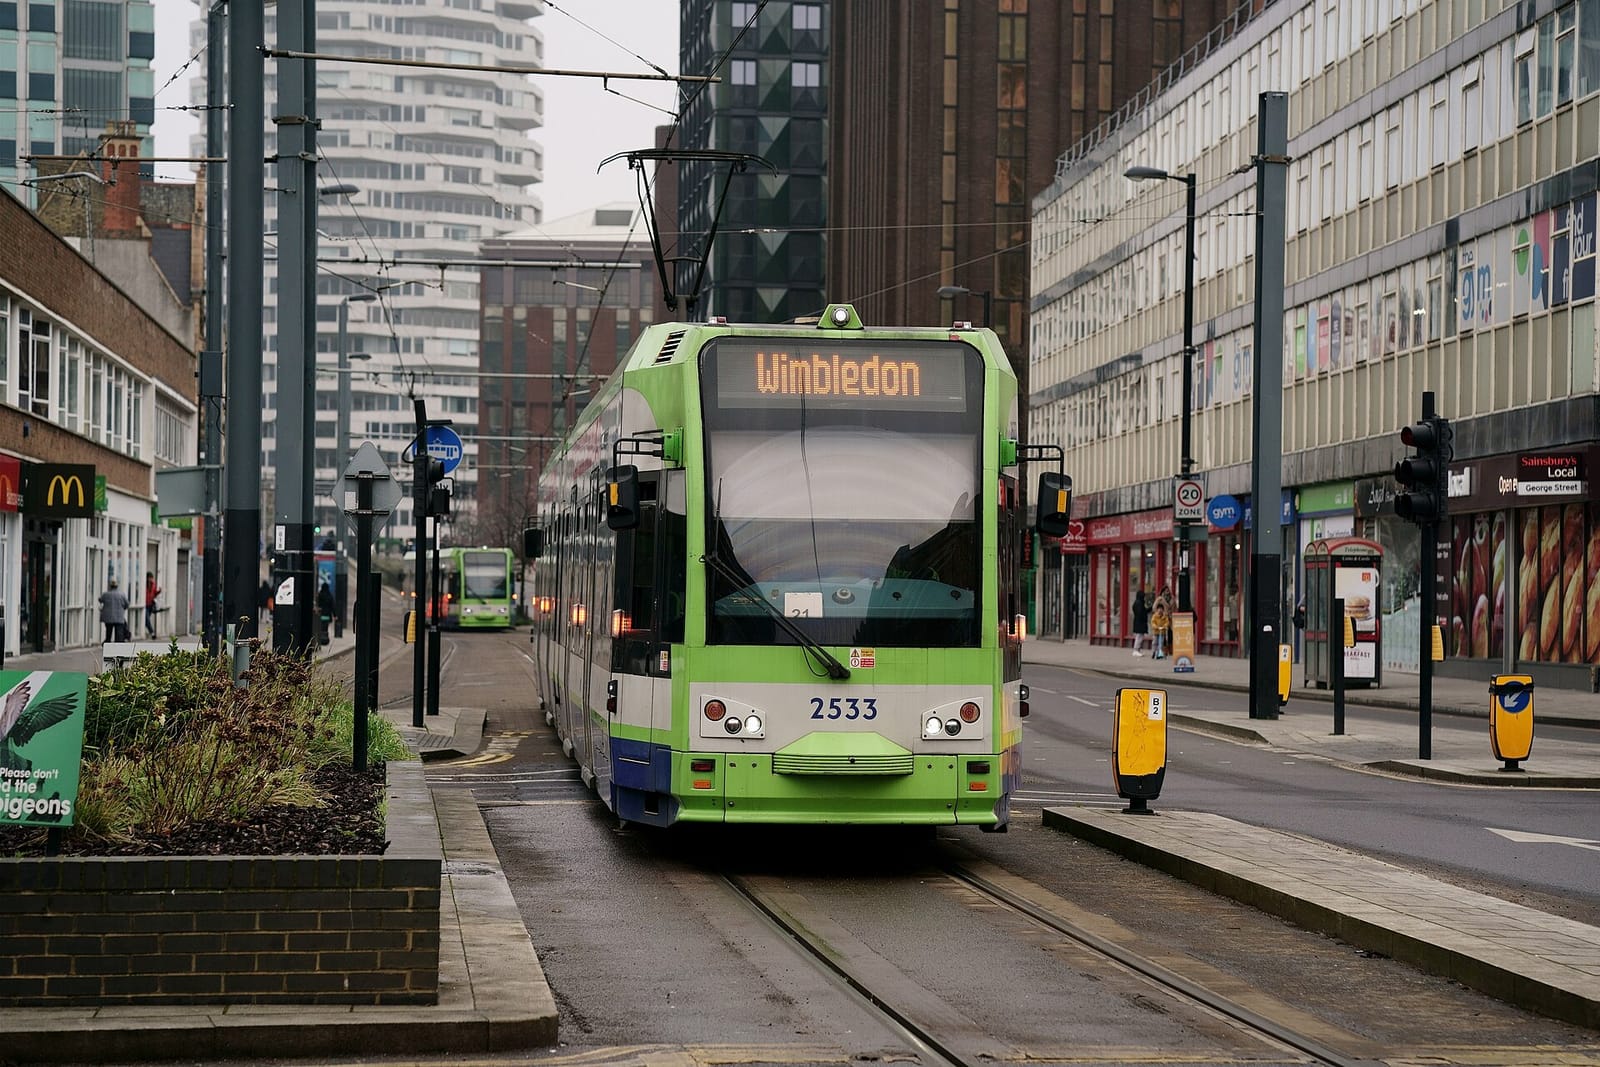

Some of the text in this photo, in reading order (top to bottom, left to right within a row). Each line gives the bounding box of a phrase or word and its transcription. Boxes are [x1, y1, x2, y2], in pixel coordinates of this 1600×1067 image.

[757, 352, 921, 396] Wimbledon
[1521, 456, 1577, 467] Sainsbury's
[1547, 466, 1577, 478] Local
[1498, 475, 1512, 496] Open
[1525, 481, 1578, 493] George Street
[1182, 489, 1199, 500] 20
[1178, 508, 1201, 516] ZONE
[1212, 506, 1235, 519] gym
[810, 697, 878, 720] 2533
[0, 767, 59, 779] Please don't
[0, 779, 37, 793] d the
